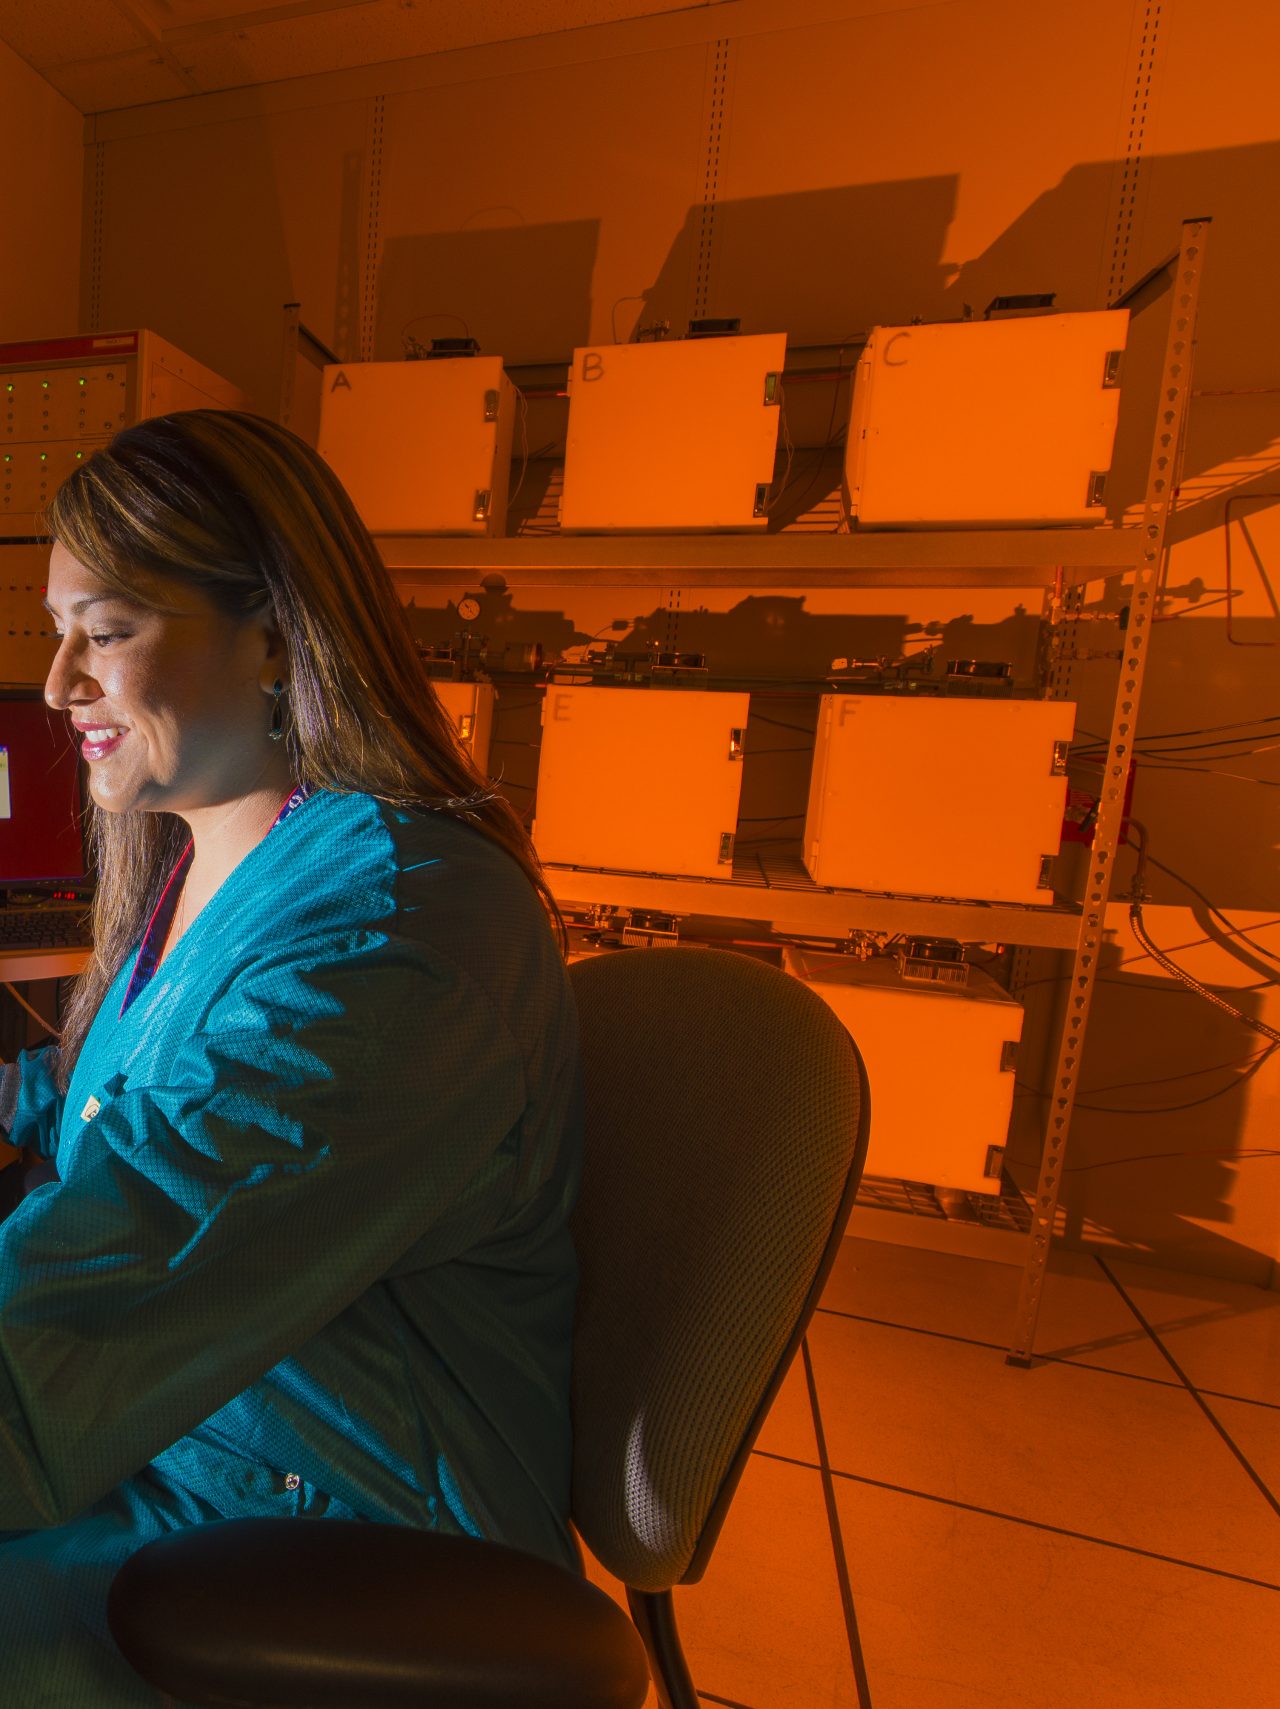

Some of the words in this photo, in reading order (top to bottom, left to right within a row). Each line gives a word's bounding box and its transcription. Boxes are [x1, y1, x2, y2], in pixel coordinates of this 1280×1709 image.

[883, 331, 912, 367] C
[331, 370, 352, 393] A
[582, 352, 605, 382] B
[553, 693, 574, 722] E
[838, 699, 862, 728] F
